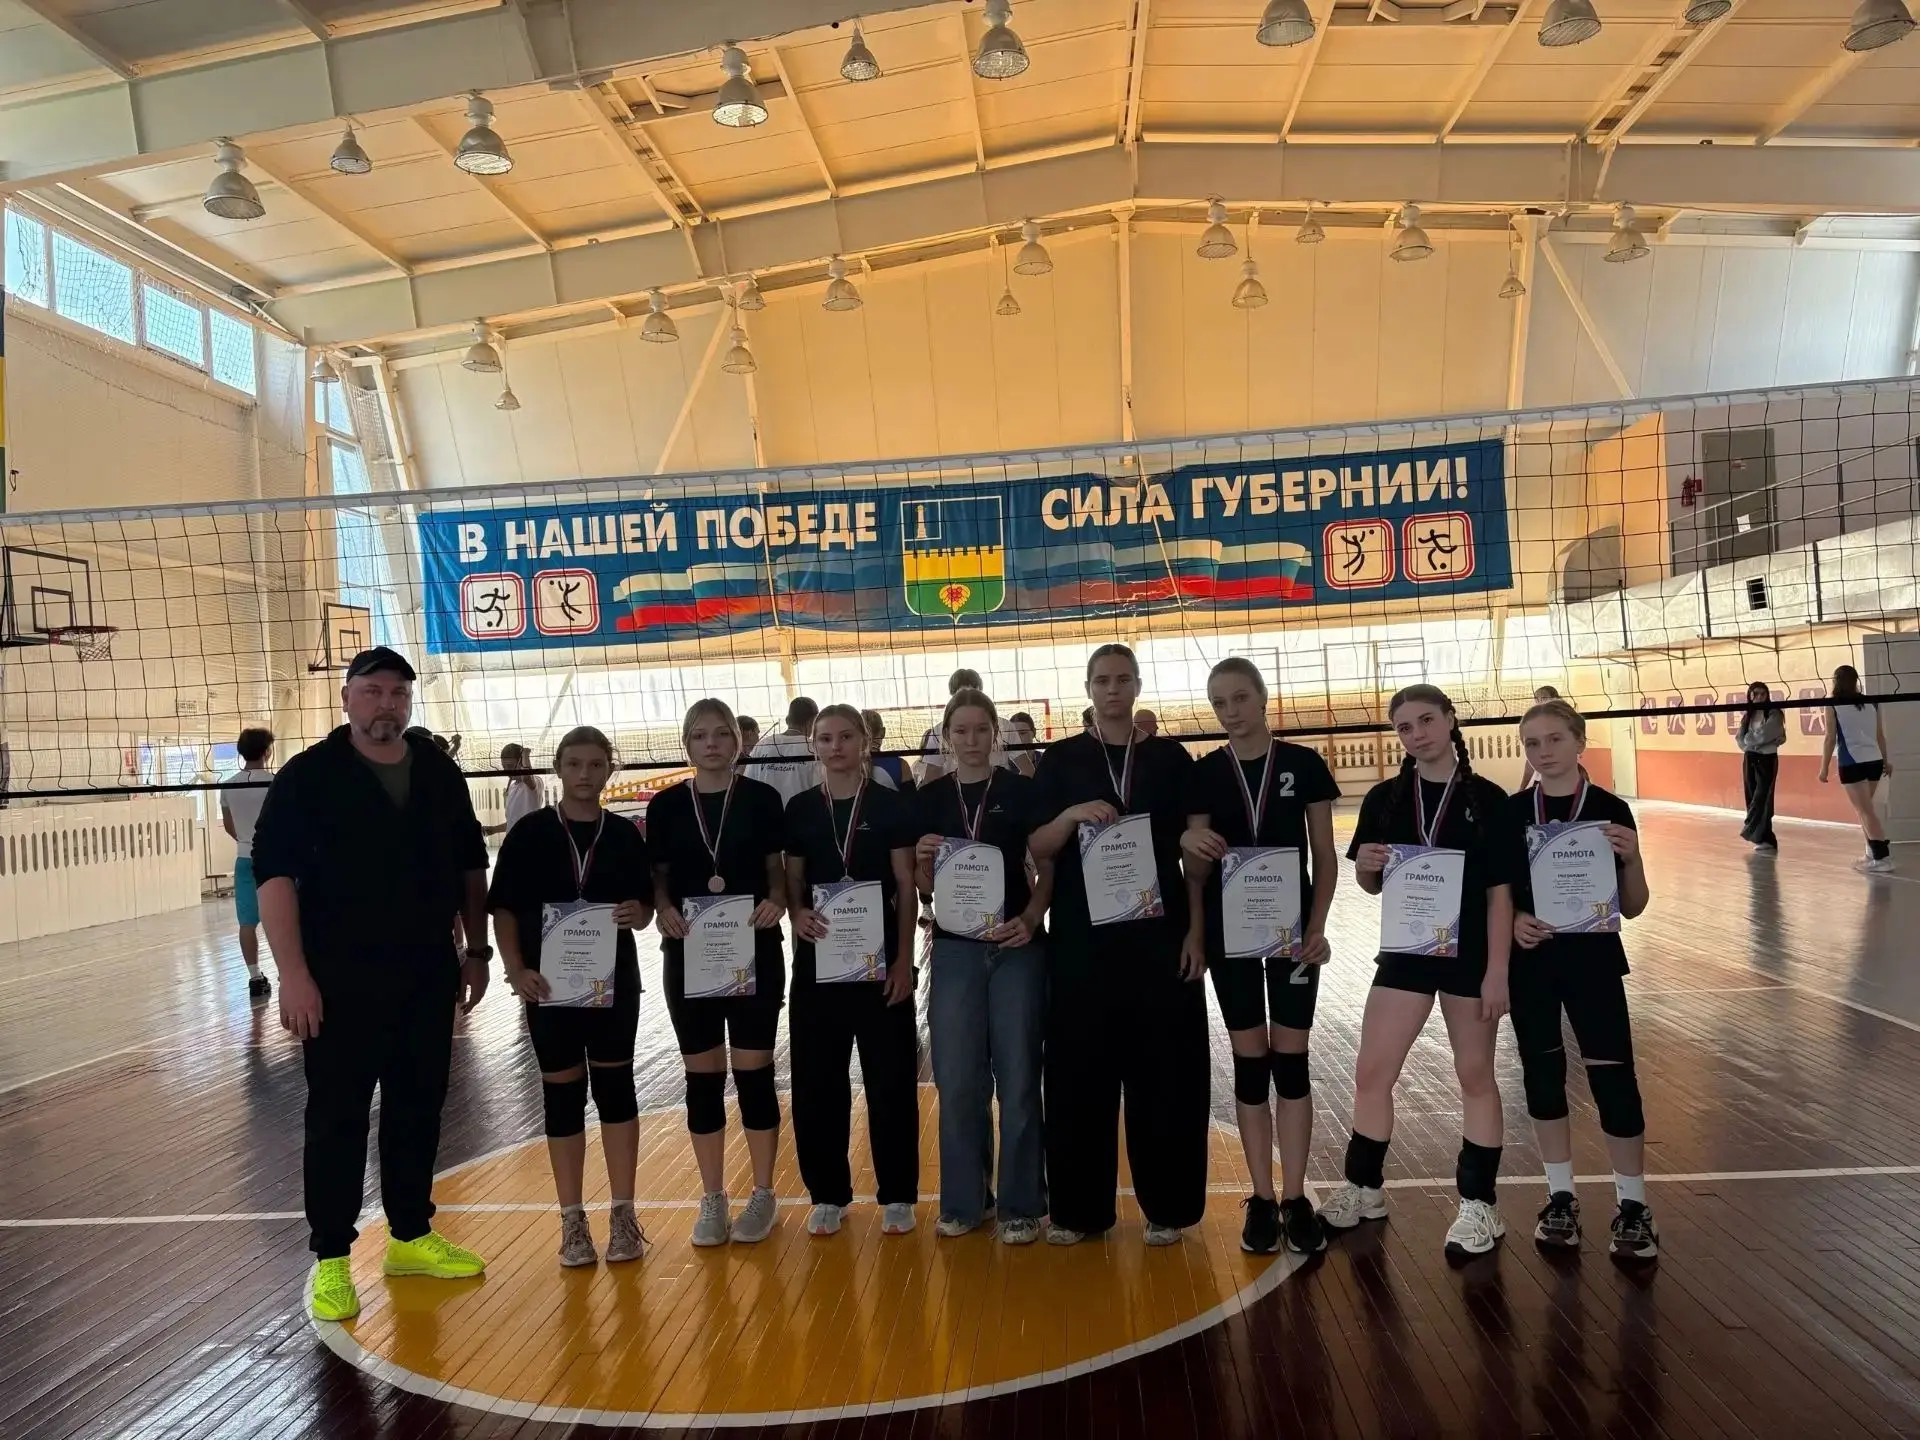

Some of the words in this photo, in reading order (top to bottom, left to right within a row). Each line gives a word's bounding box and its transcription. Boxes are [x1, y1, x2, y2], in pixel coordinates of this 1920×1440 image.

[1040, 484, 1175, 531] СИЛА
[1191, 456, 1469, 519] ГУБЕРНИИ!
[456, 523, 488, 563] В
[505, 501, 678, 561] НАШЕЙ
[696, 502, 879, 552] ПОБЕДЕ
[1280, 772, 1295, 796] 2
[1100, 841, 1137, 852] ГРАМОТА
[1552, 850, 1595, 859] ГРАМОТА
[954, 863, 990, 872] ГРАМОТА
[1244, 875, 1283, 883] ГРАМОТА
[1405, 872, 1445, 883] ГРАМОТА
[833, 906, 868, 915] ГРАМОТА
[703, 921, 739, 929] ГРАМОТА
[563, 929, 601, 937] ГРАМОТА
